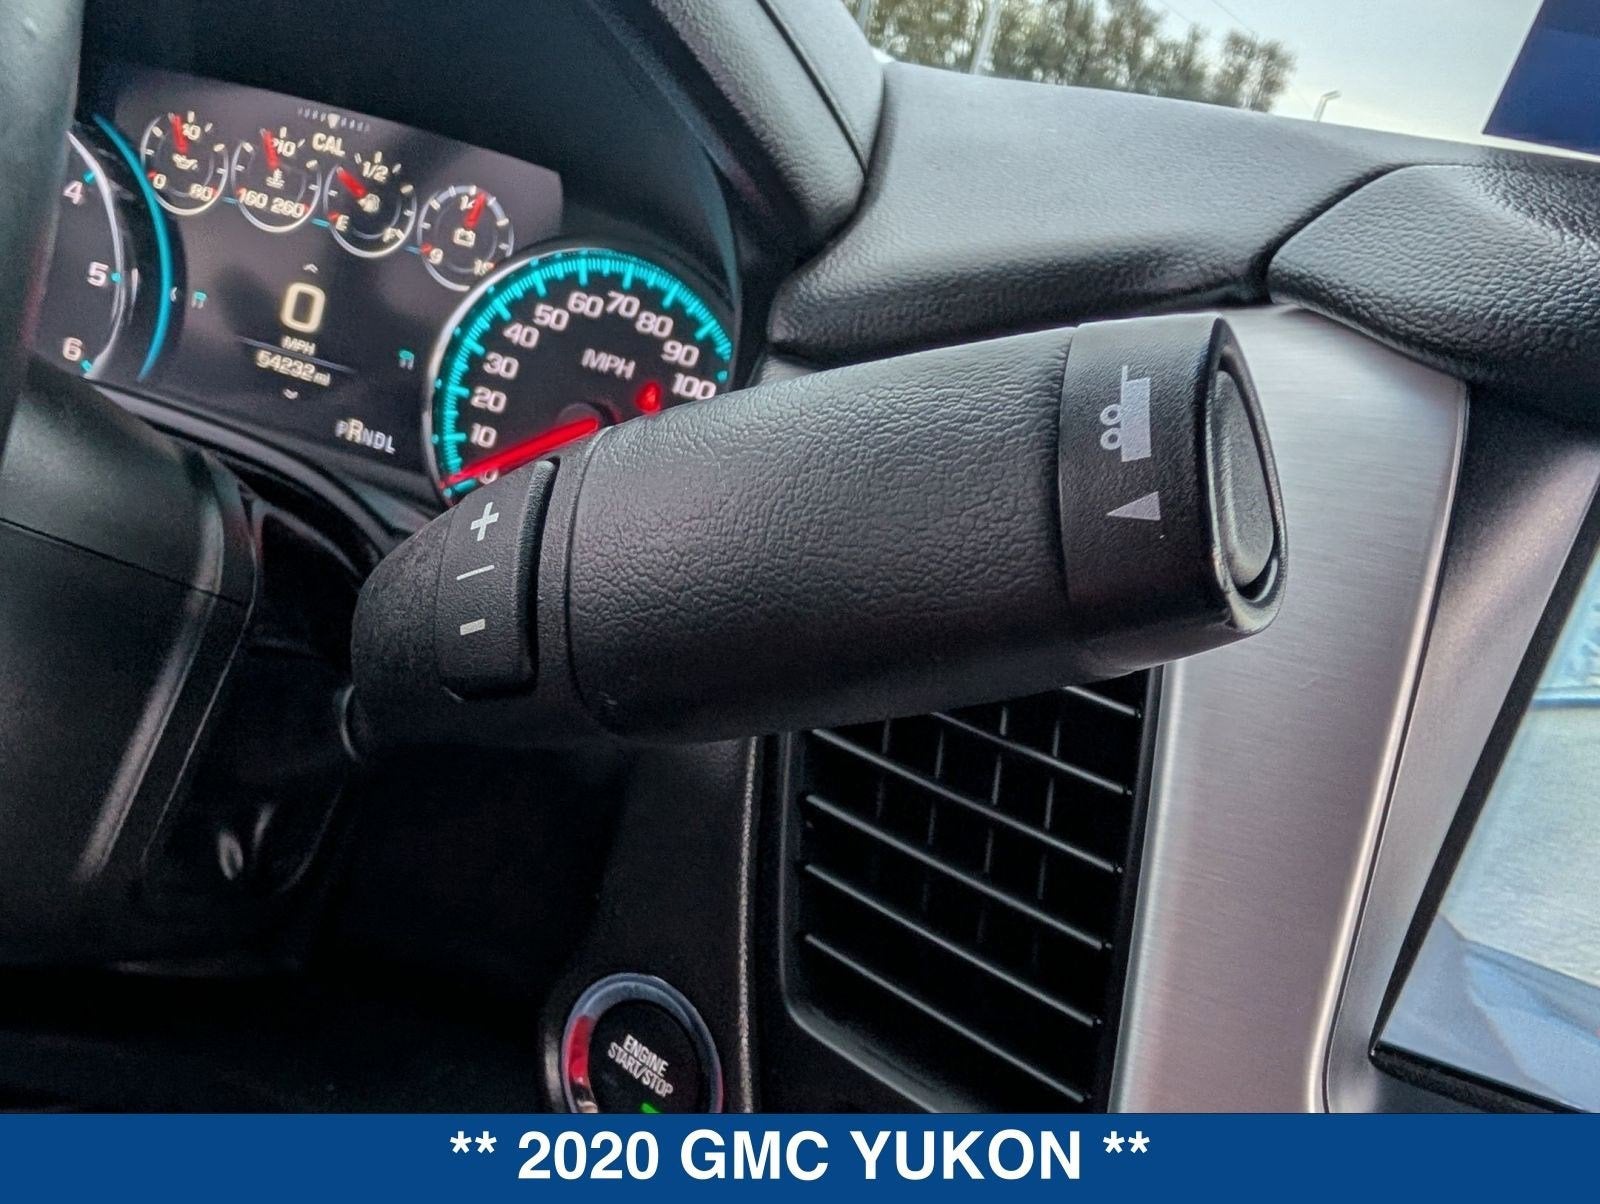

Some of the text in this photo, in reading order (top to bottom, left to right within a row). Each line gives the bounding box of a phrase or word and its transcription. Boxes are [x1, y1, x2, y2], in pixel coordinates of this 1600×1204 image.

[312, 132, 346, 157] CAL
[153, 174, 167, 189] 0
[362, 160, 389, 183] 1/2
[63, 180, 84, 205] 4
[238, 187, 268, 209] 160
[270, 196, 305, 219] 260
[429, 247, 444, 265] 9
[87, 261, 110, 288] 5
[280, 282, 326, 333] 0
[532, 303, 570, 332] 50
[566, 291, 605, 320] 60
[606, 290, 641, 319] 70
[503, 322, 540, 349] 40
[634, 310, 675, 339] 80
[62, 336, 84, 362] 6
[282, 336, 316, 355] MPH
[661, 340, 701, 368] 90
[482, 352, 519, 380] 30
[581, 348, 636, 379] MPH
[469, 386, 507, 413] 20
[671, 372, 717, 401] 100
[470, 422, 498, 449] 10
[622, 1034, 669, 1077] ENGINE
[607, 1042, 673, 1098] START/STOP
